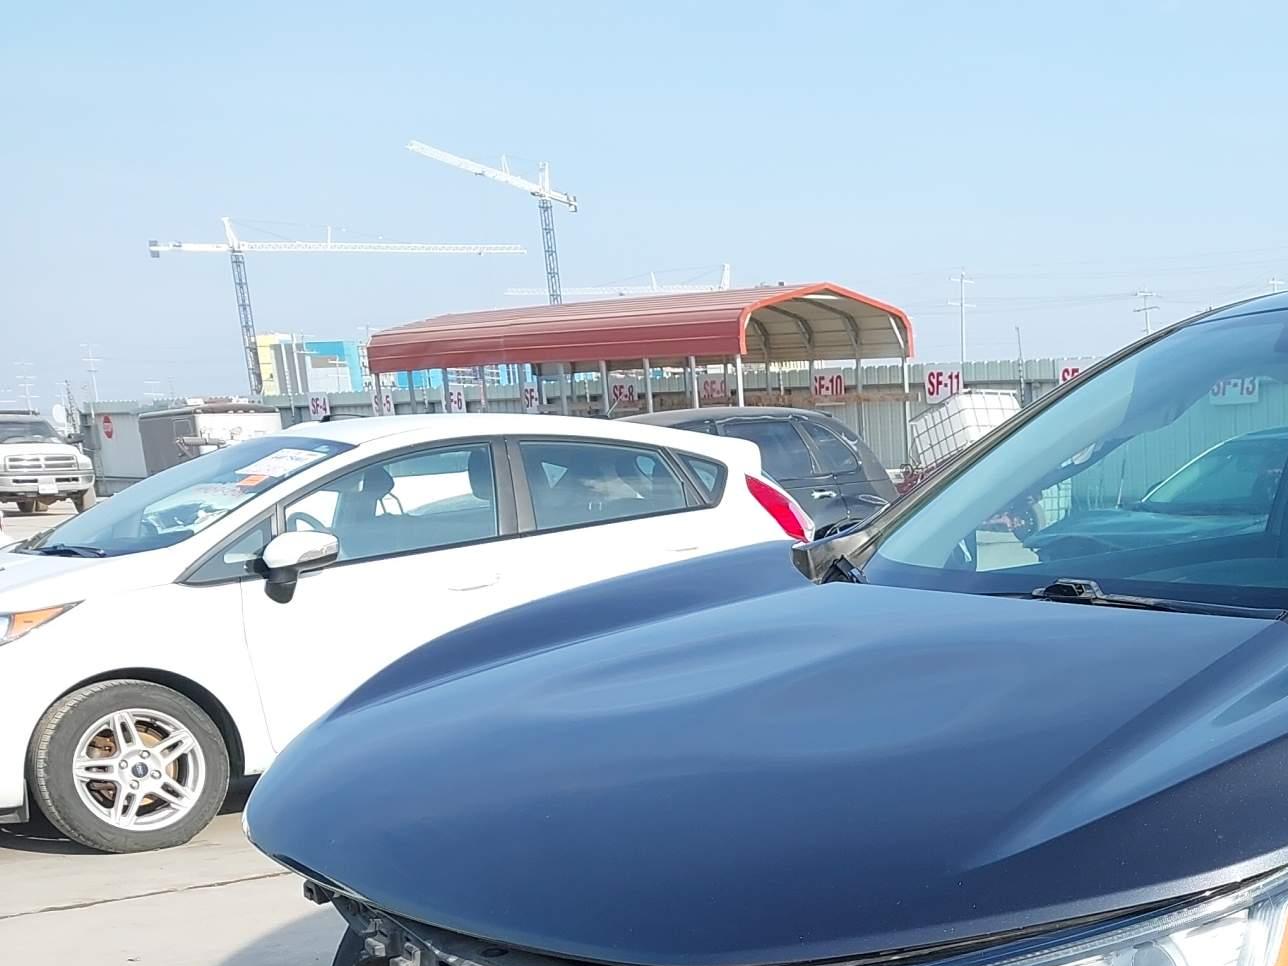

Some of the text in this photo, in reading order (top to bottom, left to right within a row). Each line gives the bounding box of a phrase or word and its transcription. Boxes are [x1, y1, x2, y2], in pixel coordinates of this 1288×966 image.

[927, 370, 960, 397] SF-11
[310, 397, 328, 415] SF-4
[374, 395, 391, 413] S-5
